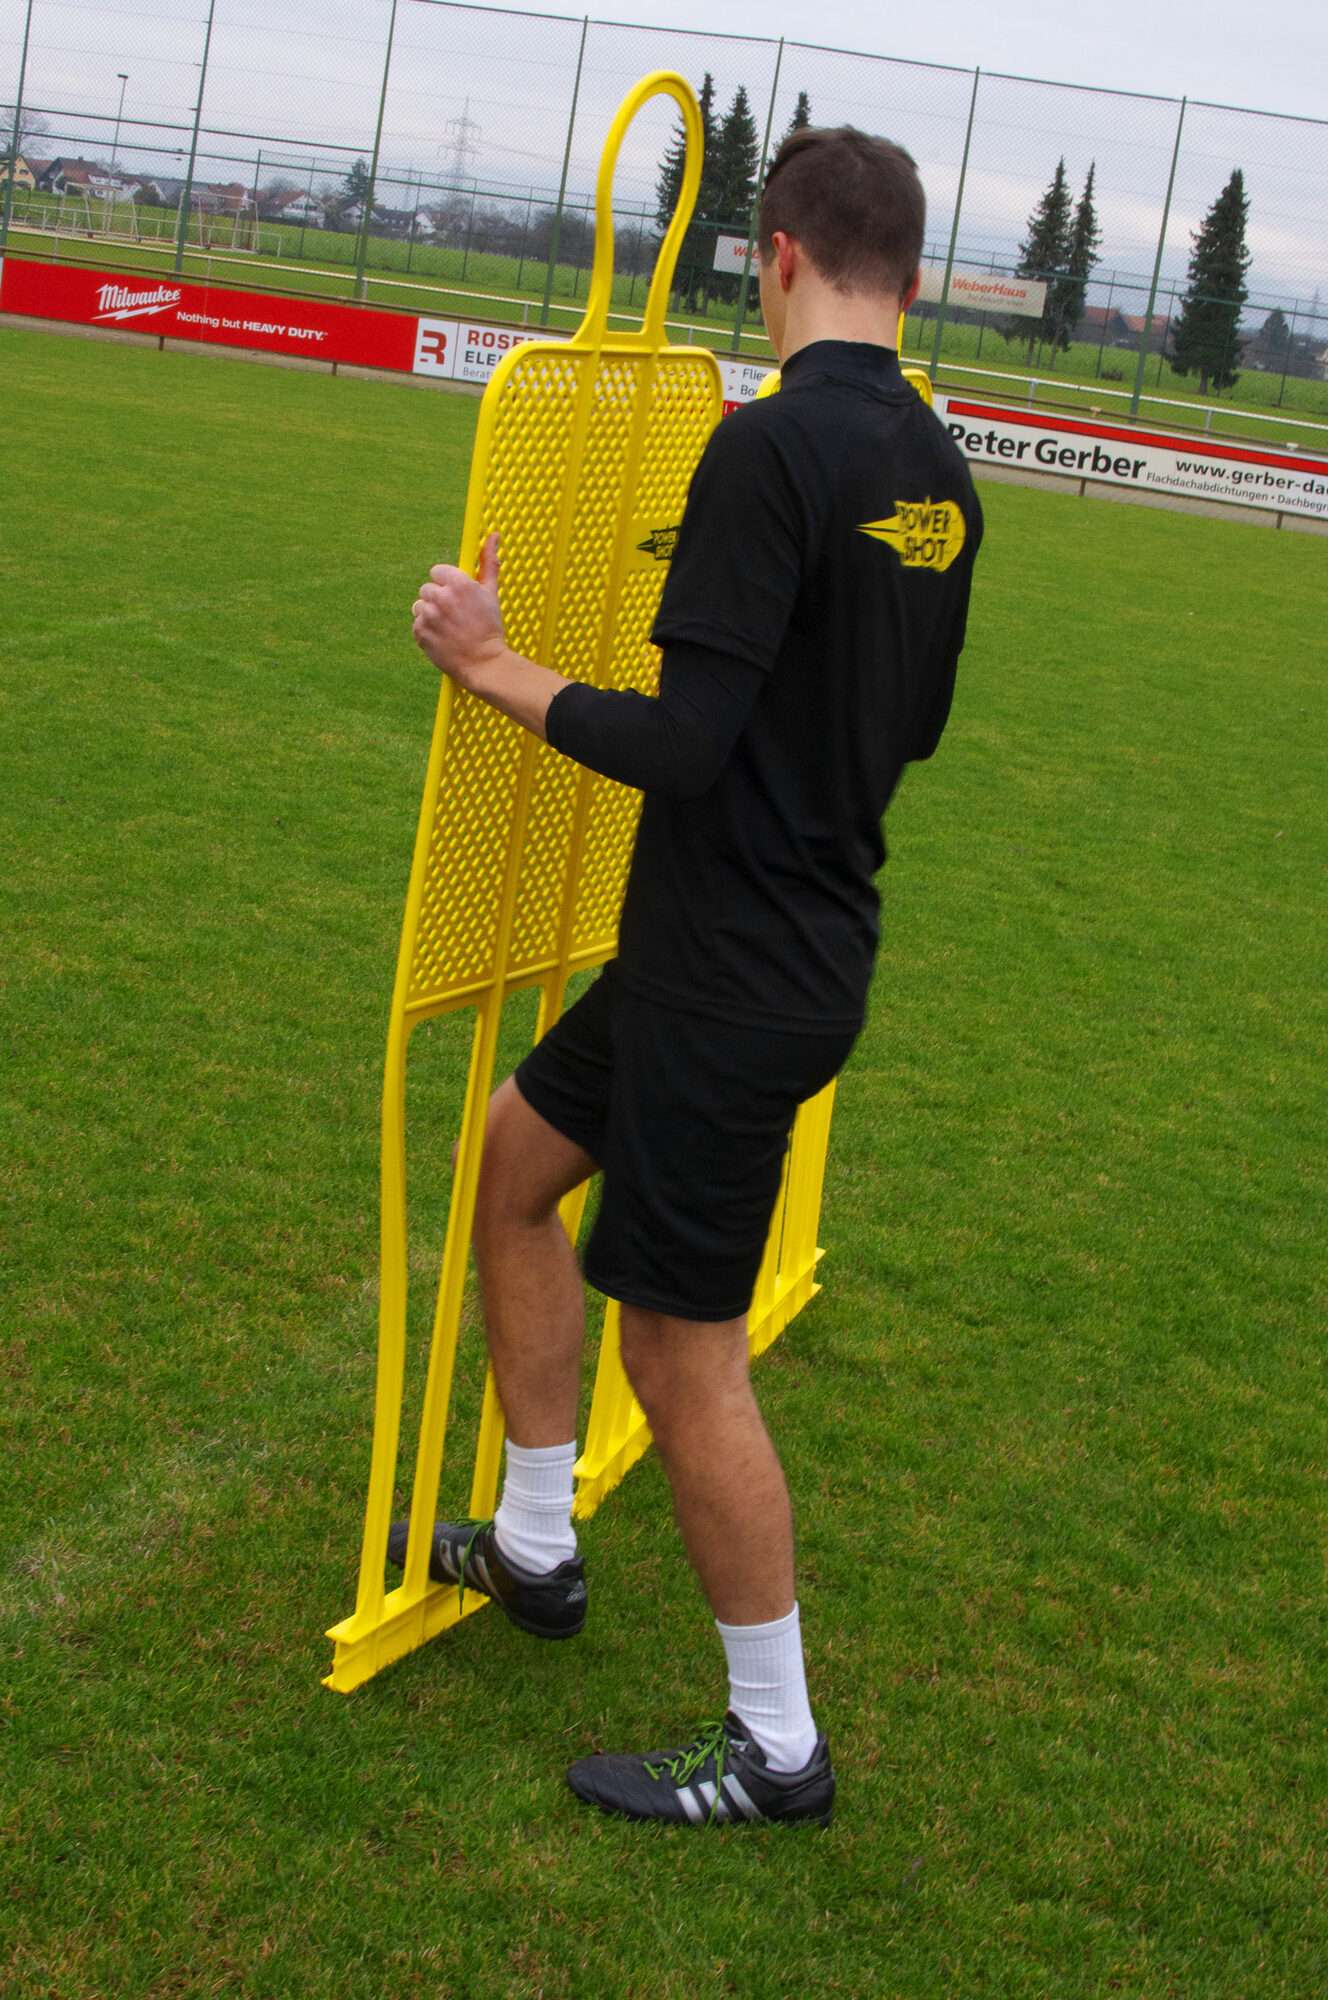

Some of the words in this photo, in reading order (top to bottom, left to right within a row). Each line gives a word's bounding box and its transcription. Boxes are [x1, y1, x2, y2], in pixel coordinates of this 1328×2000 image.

[96, 284, 181, 311] Milwaukee
[952, 277, 1027, 298] WeberHaus
[176, 311, 220, 328] Nothing
[222, 317, 241, 329] but
[242, 320, 286, 335] HEAVY
[467, 330, 535, 350] ROSE
[464, 350, 503, 366] ELE
[948, 423, 1031, 460] Peter
[1035, 438, 1148, 479] Gerber
[1146, 472, 1269, 501] Flachdachabdichtungen
[1176, 460, 1328, 495] www.gerber-da
[896, 504, 952, 534] POWER
[903, 535, 948, 562] SHOT
